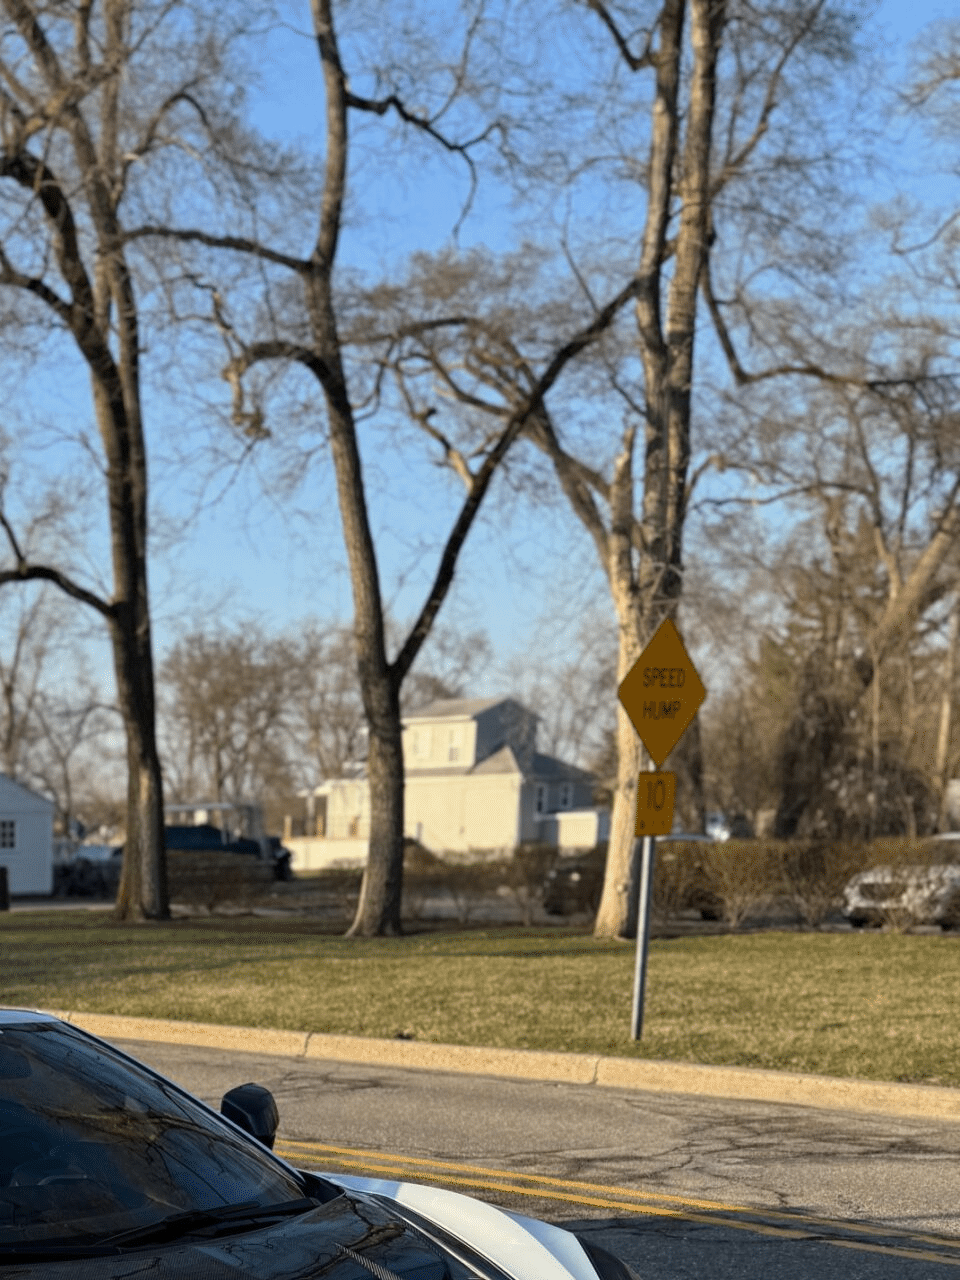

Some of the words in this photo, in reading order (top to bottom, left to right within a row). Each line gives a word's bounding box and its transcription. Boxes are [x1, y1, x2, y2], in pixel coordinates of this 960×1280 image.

[642, 667, 685, 688] SPEED
[642, 700, 681, 720] HUMP
[645, 780, 666, 812] 10
